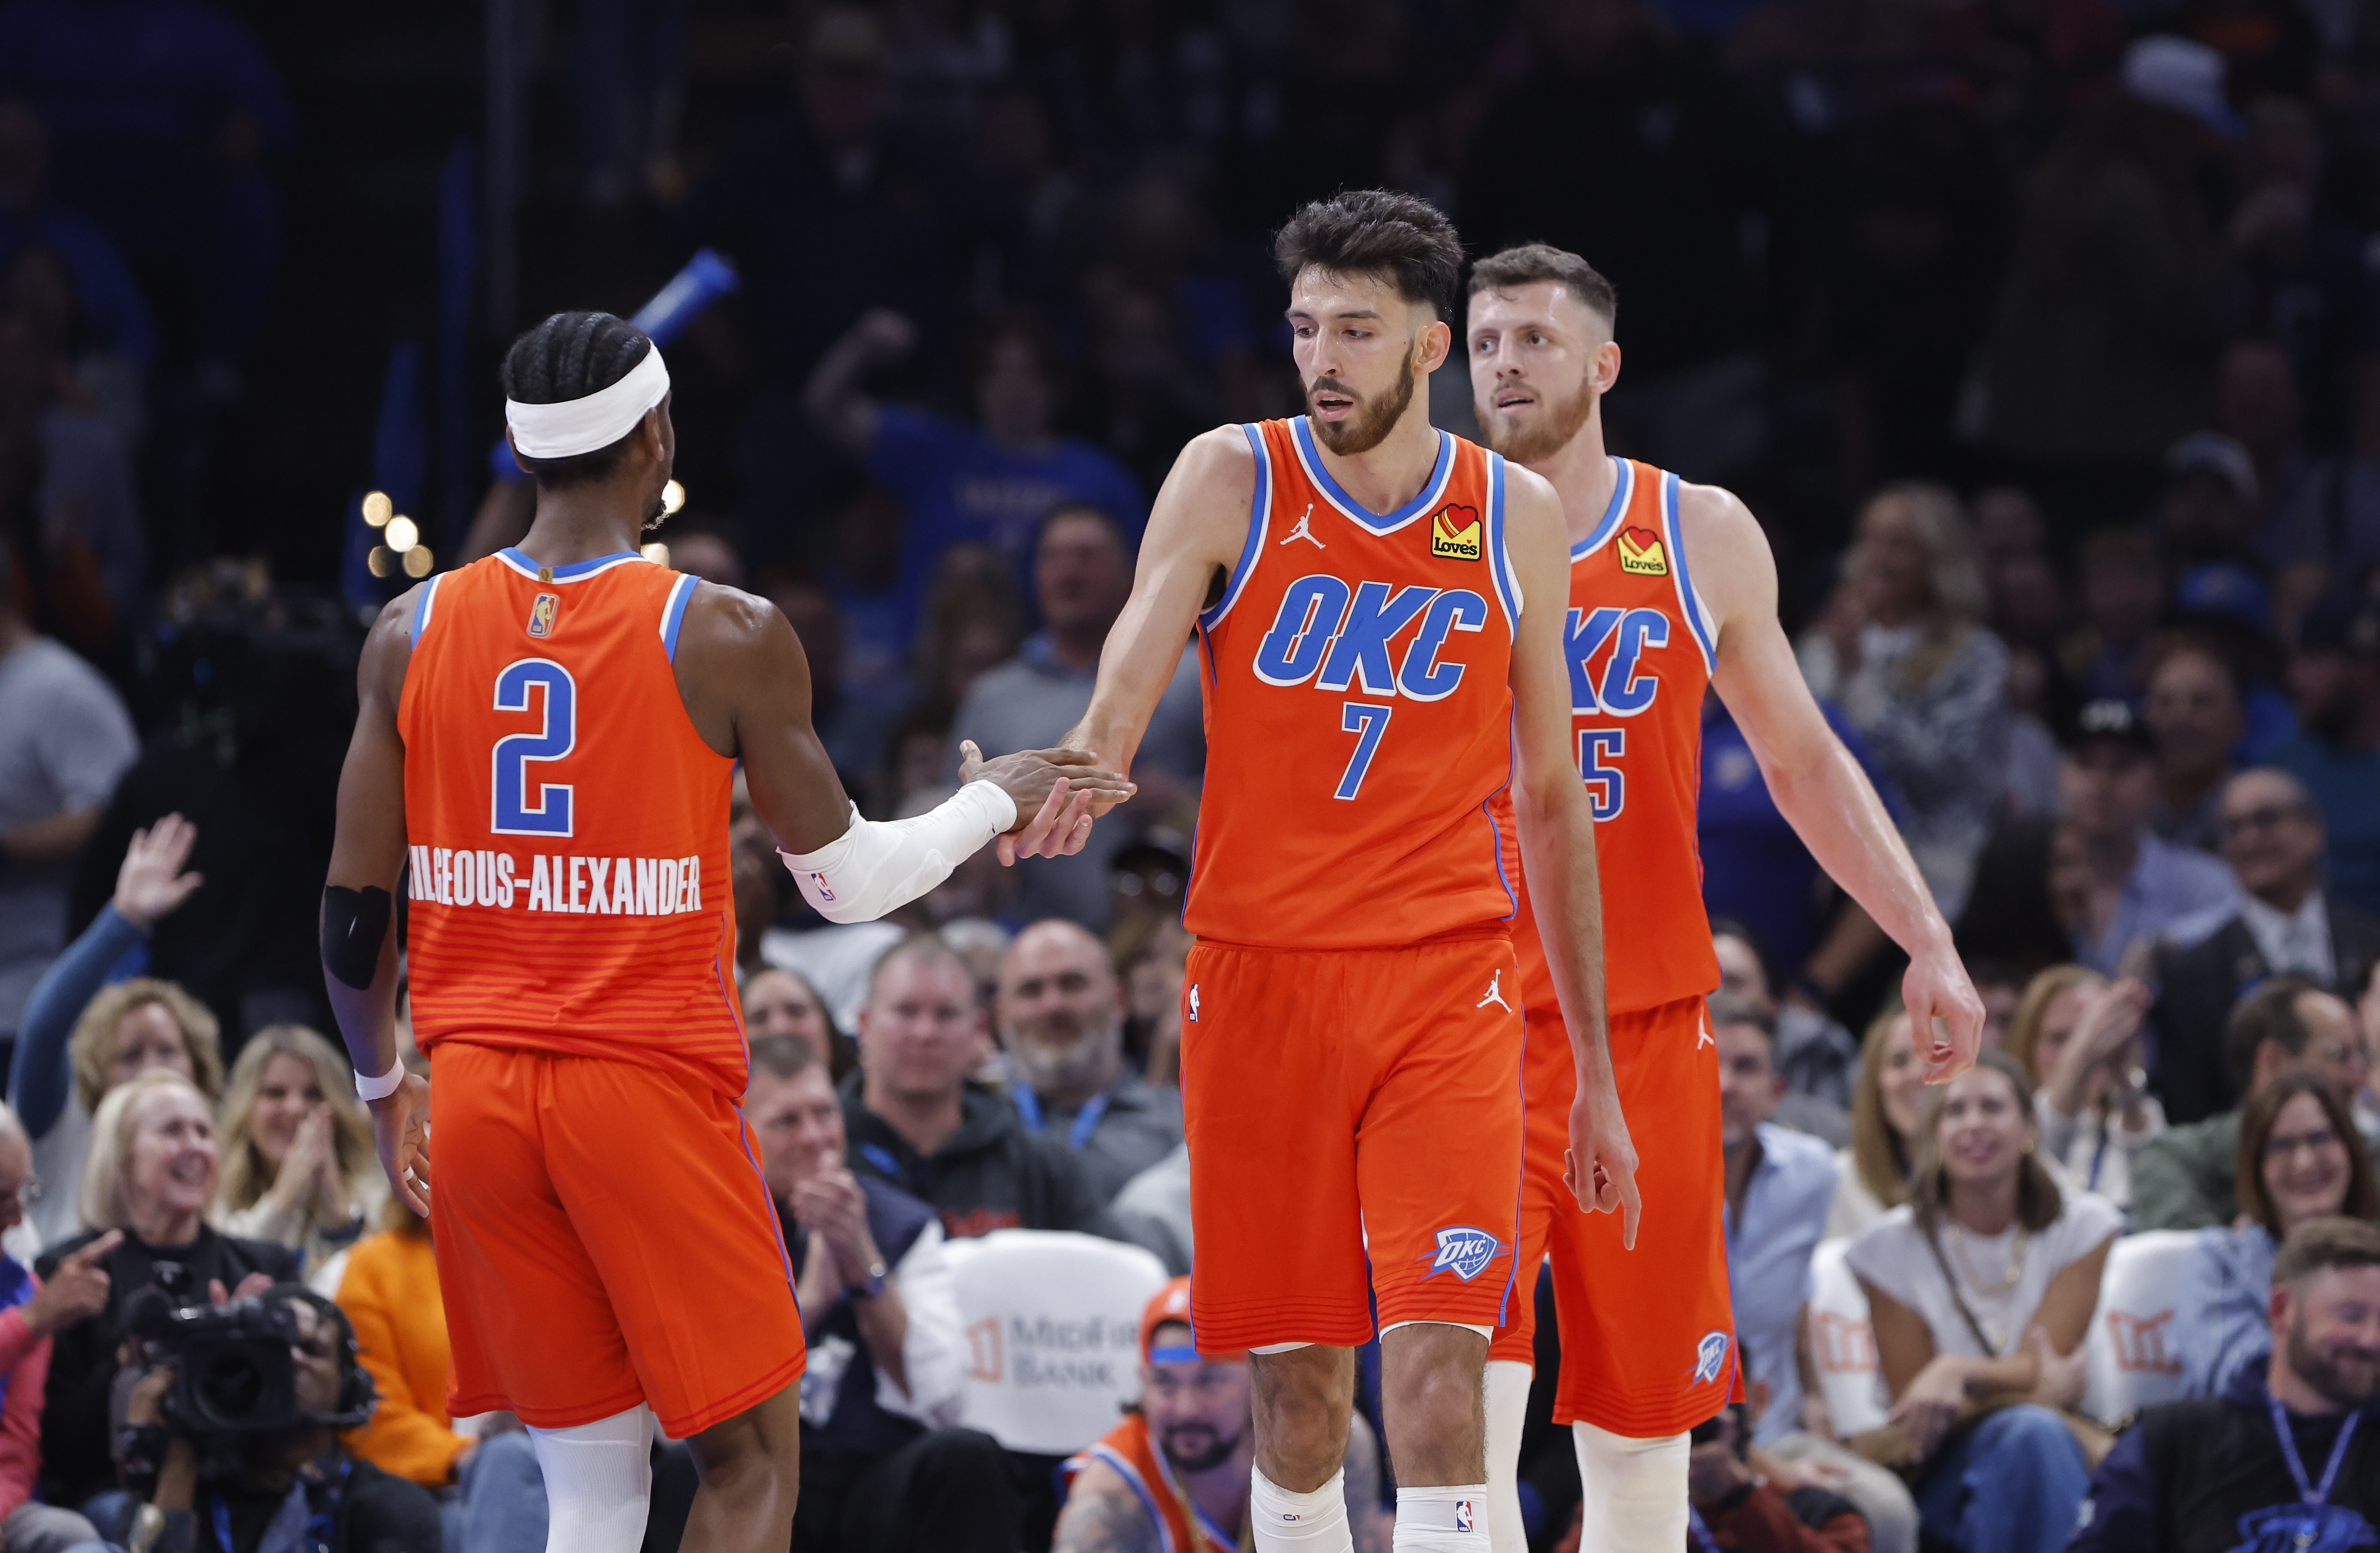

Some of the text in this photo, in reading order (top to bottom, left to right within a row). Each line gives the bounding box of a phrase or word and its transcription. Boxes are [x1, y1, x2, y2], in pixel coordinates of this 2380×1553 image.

[1253, 574, 1488, 702] OKC
[1563, 607, 1670, 717] KC
[491, 657, 576, 838] 2
[1333, 701, 1392, 801] 7
[1578, 727, 1625, 822] 5
[1434, 1239, 1486, 1267] OKC
